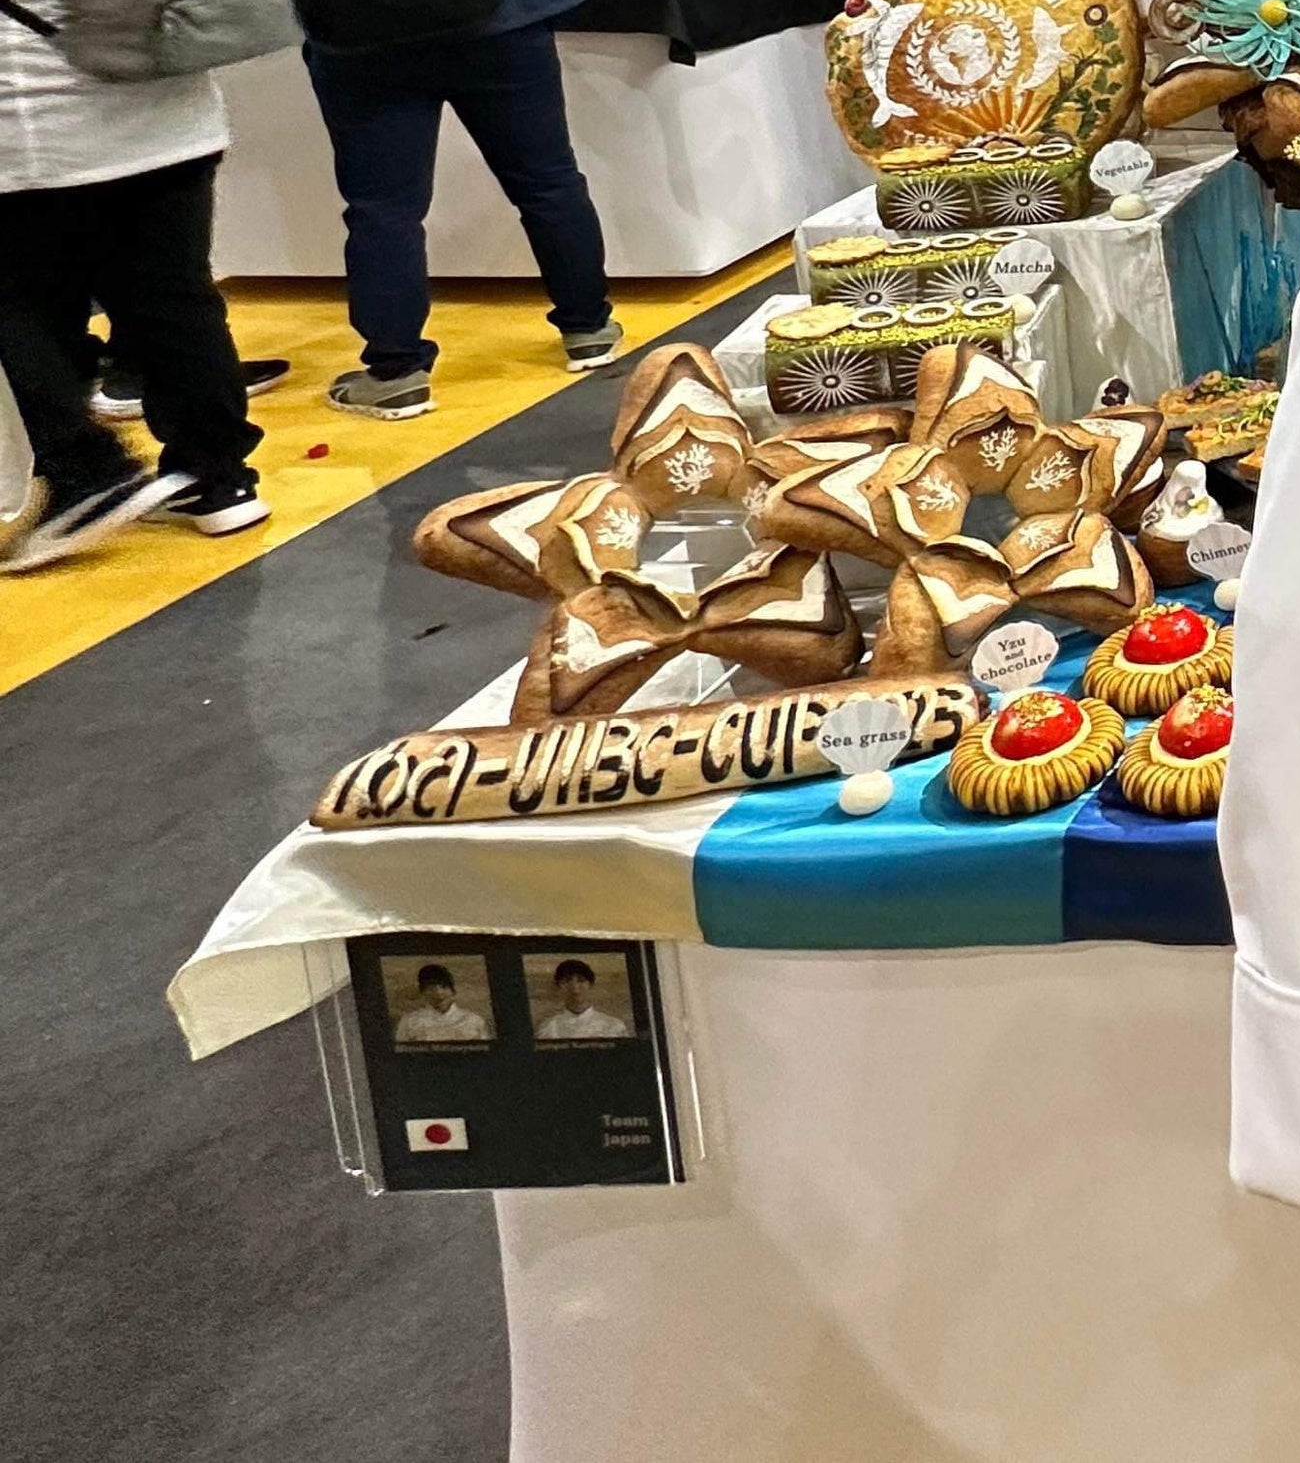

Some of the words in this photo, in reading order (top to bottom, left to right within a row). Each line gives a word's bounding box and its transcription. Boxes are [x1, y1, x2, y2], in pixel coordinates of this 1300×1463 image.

[1095, 159, 1150, 178] Vegetable
[994, 260, 1053, 275] Matcha
[997, 637, 1027, 653] Yzu
[1004, 649, 1026, 662] and
[980, 652, 1053, 682] chocolate
[821, 734, 853, 748] Sea
[859, 730, 907, 748] grass
[602, 1114, 649, 1127] Team
